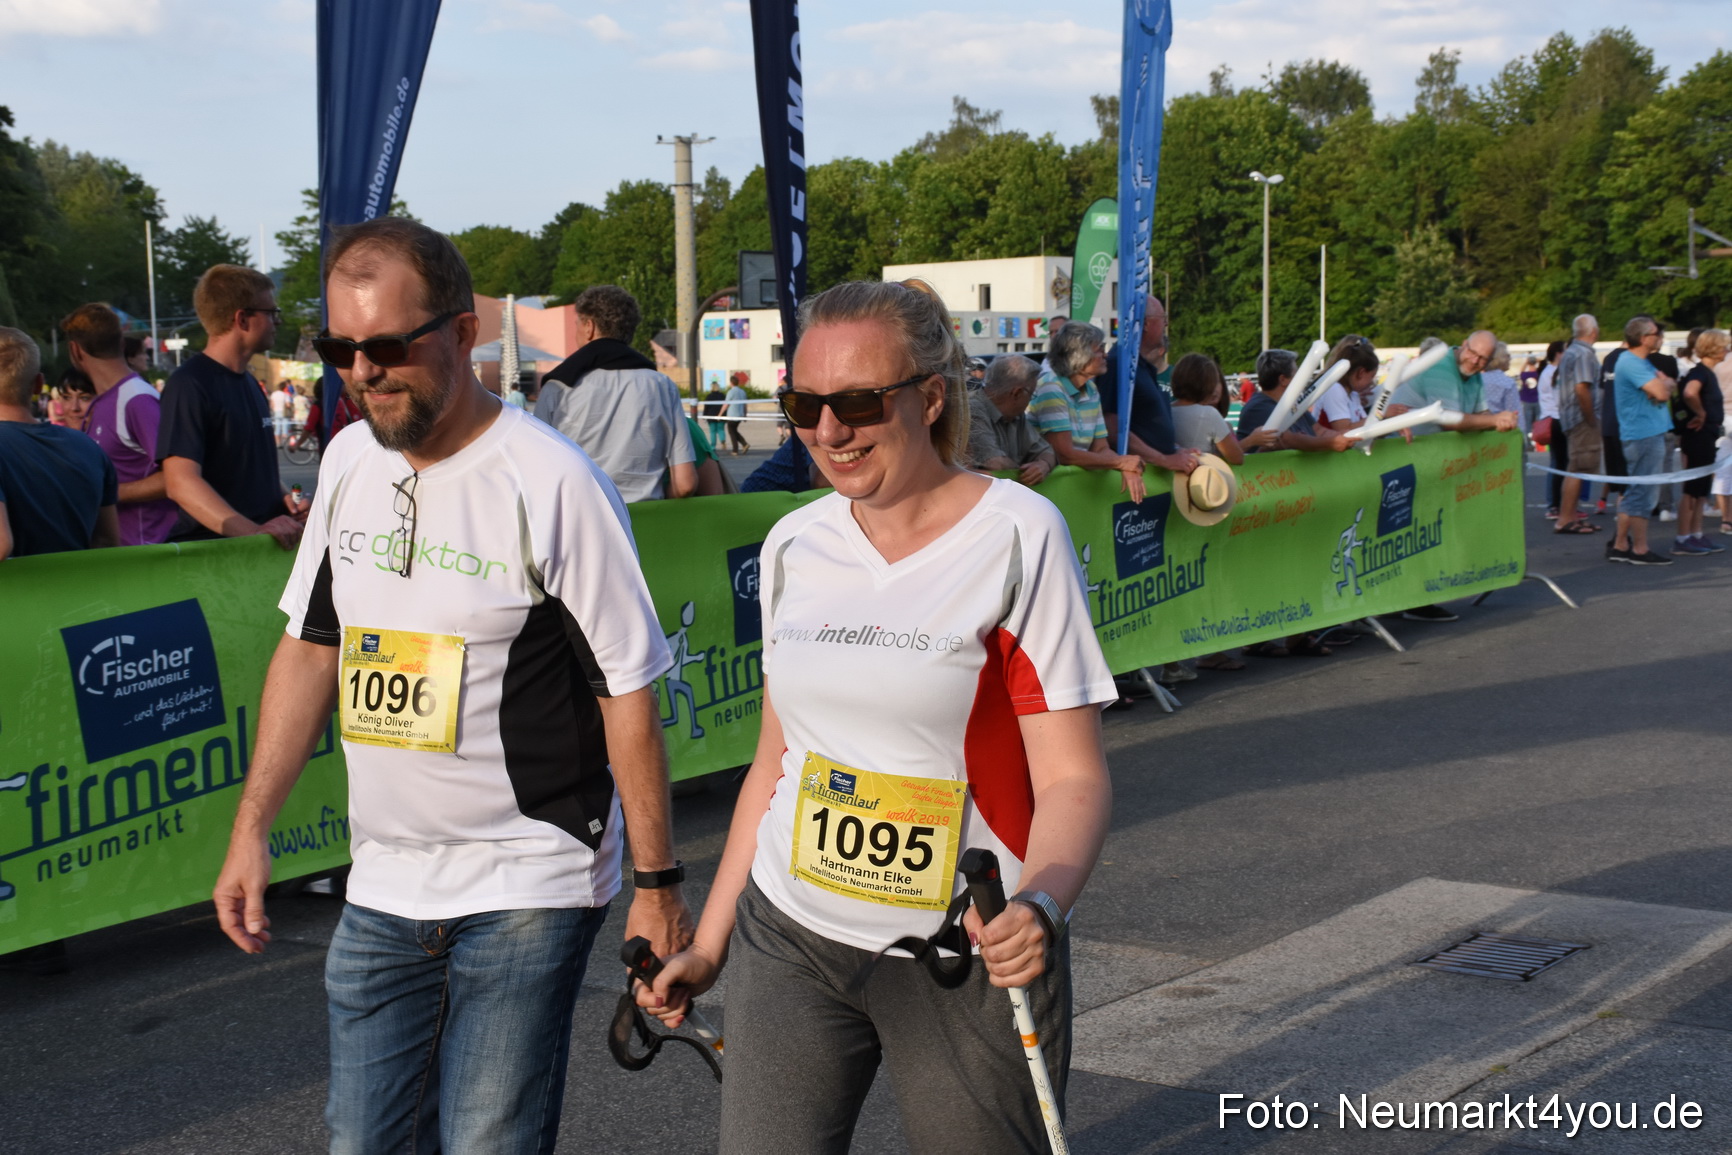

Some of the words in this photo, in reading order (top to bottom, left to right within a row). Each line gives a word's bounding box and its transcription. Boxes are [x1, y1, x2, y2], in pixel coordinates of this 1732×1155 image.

[363, 76, 411, 223] automobile.de
[1122, 518, 1159, 539] Fischer
[1361, 508, 1443, 573] firmenlauf
[1098, 542, 1209, 626] firmenlauf
[772, 623, 964, 653] www.intellitools.de
[1104, 613, 1152, 644] neumarkt
[102, 645, 194, 687] Fischer
[353, 648, 397, 664] firmenlauf
[114, 669, 190, 699] AUTOMOBILE
[350, 669, 437, 718] 1096
[348, 723, 372, 734] Intellitools
[373, 726, 404, 738] Neumarkt
[405, 730, 429, 740] GmbH
[357, 712, 382, 728] König
[384, 715, 414, 729] Oliver
[818, 783, 881, 810] firmenlauf
[901, 779, 930, 792] Gesunde
[886, 808, 917, 823] walk
[918, 814, 950, 826] 2019
[37, 808, 184, 883] neumarkt
[812, 807, 933, 872] 1095
[809, 864, 848, 884] Intellitools
[849, 878, 892, 893] Neumarkt
[894, 886, 923, 896] GmbH
[820, 855, 879, 880] Hartmann
[883, 871, 912, 885] Elke
